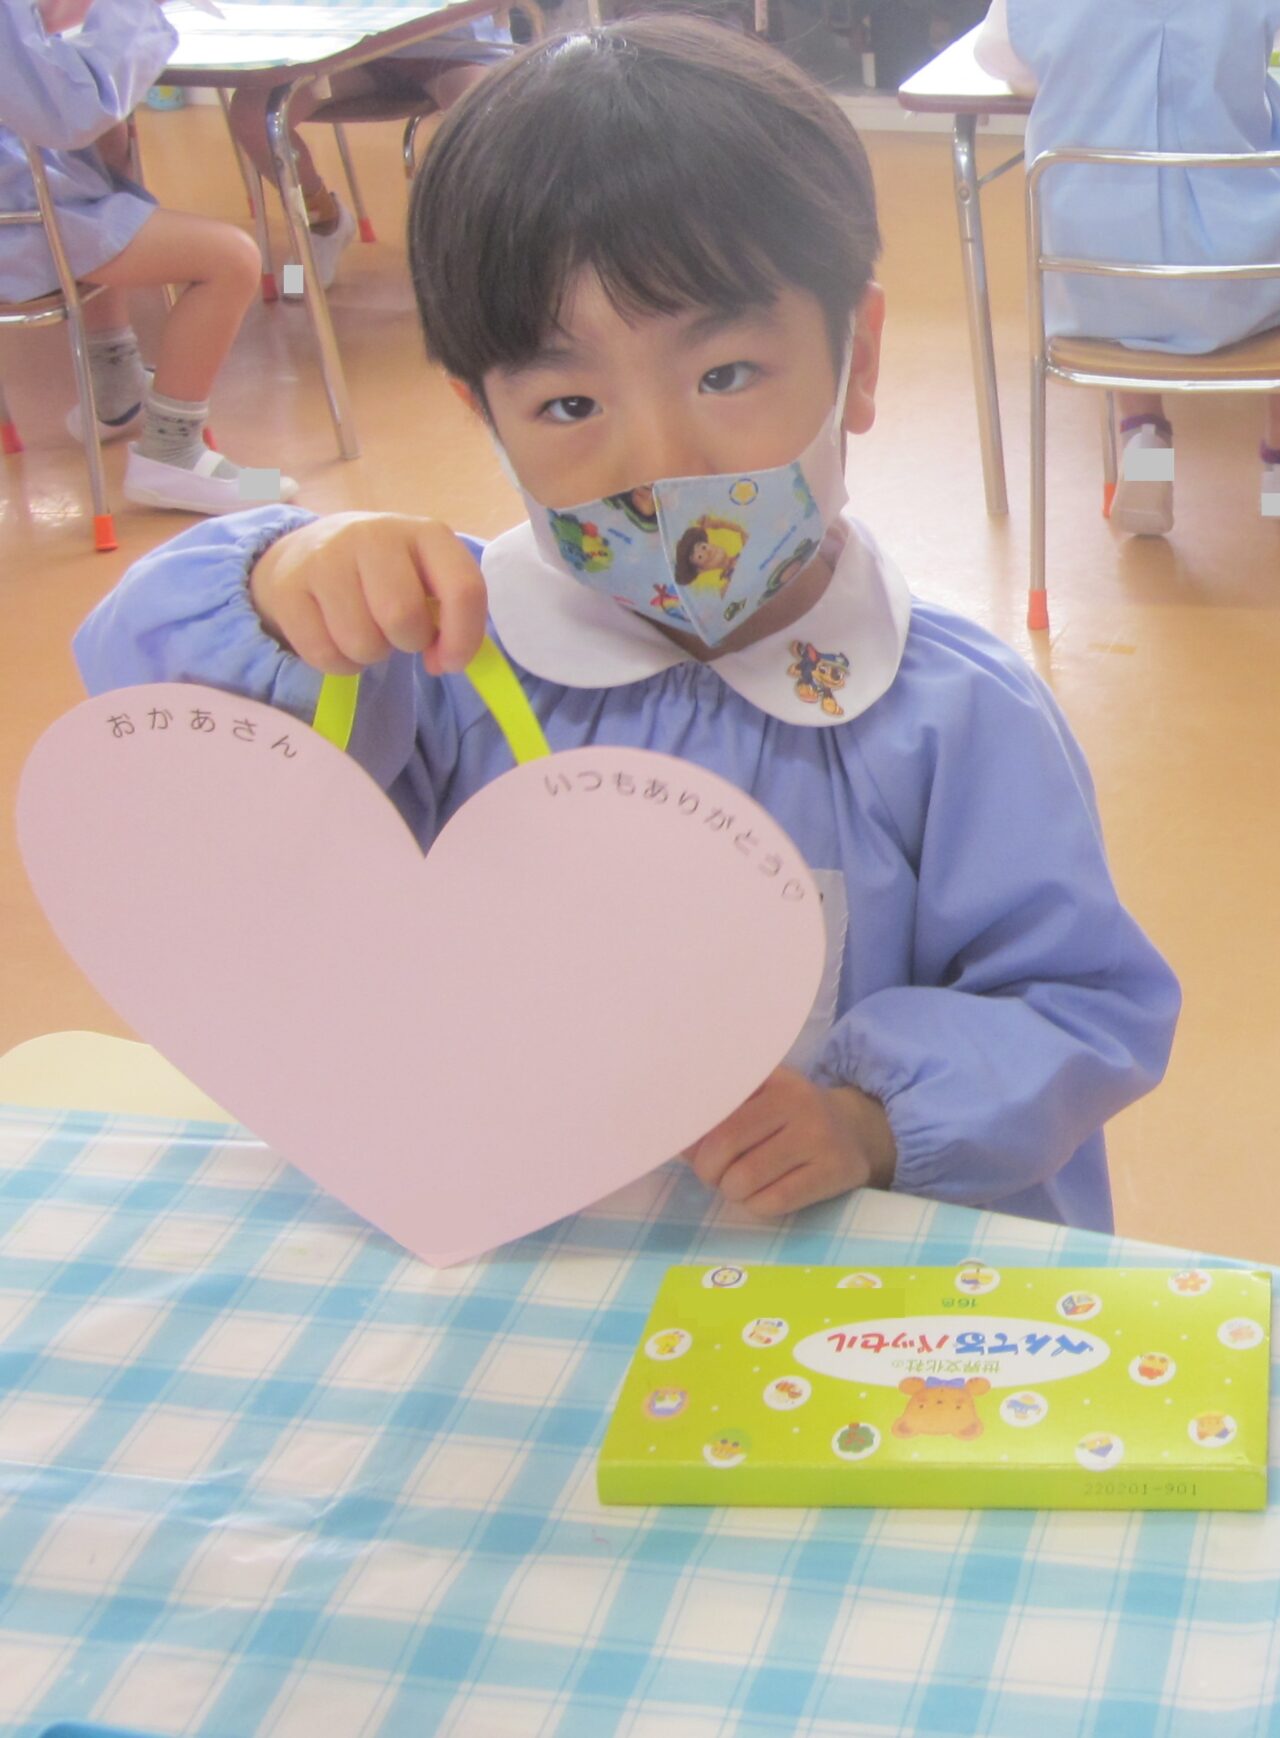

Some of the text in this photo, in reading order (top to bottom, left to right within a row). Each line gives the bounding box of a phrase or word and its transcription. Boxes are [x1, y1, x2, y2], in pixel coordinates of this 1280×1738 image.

[105, 707, 298, 759] おかあさん
[543, 770, 784, 878] いつもありがとう
[891, 1359, 1000, 1375] 世界文化社の
[1084, 1482, 1198, 1497] 220201-901
